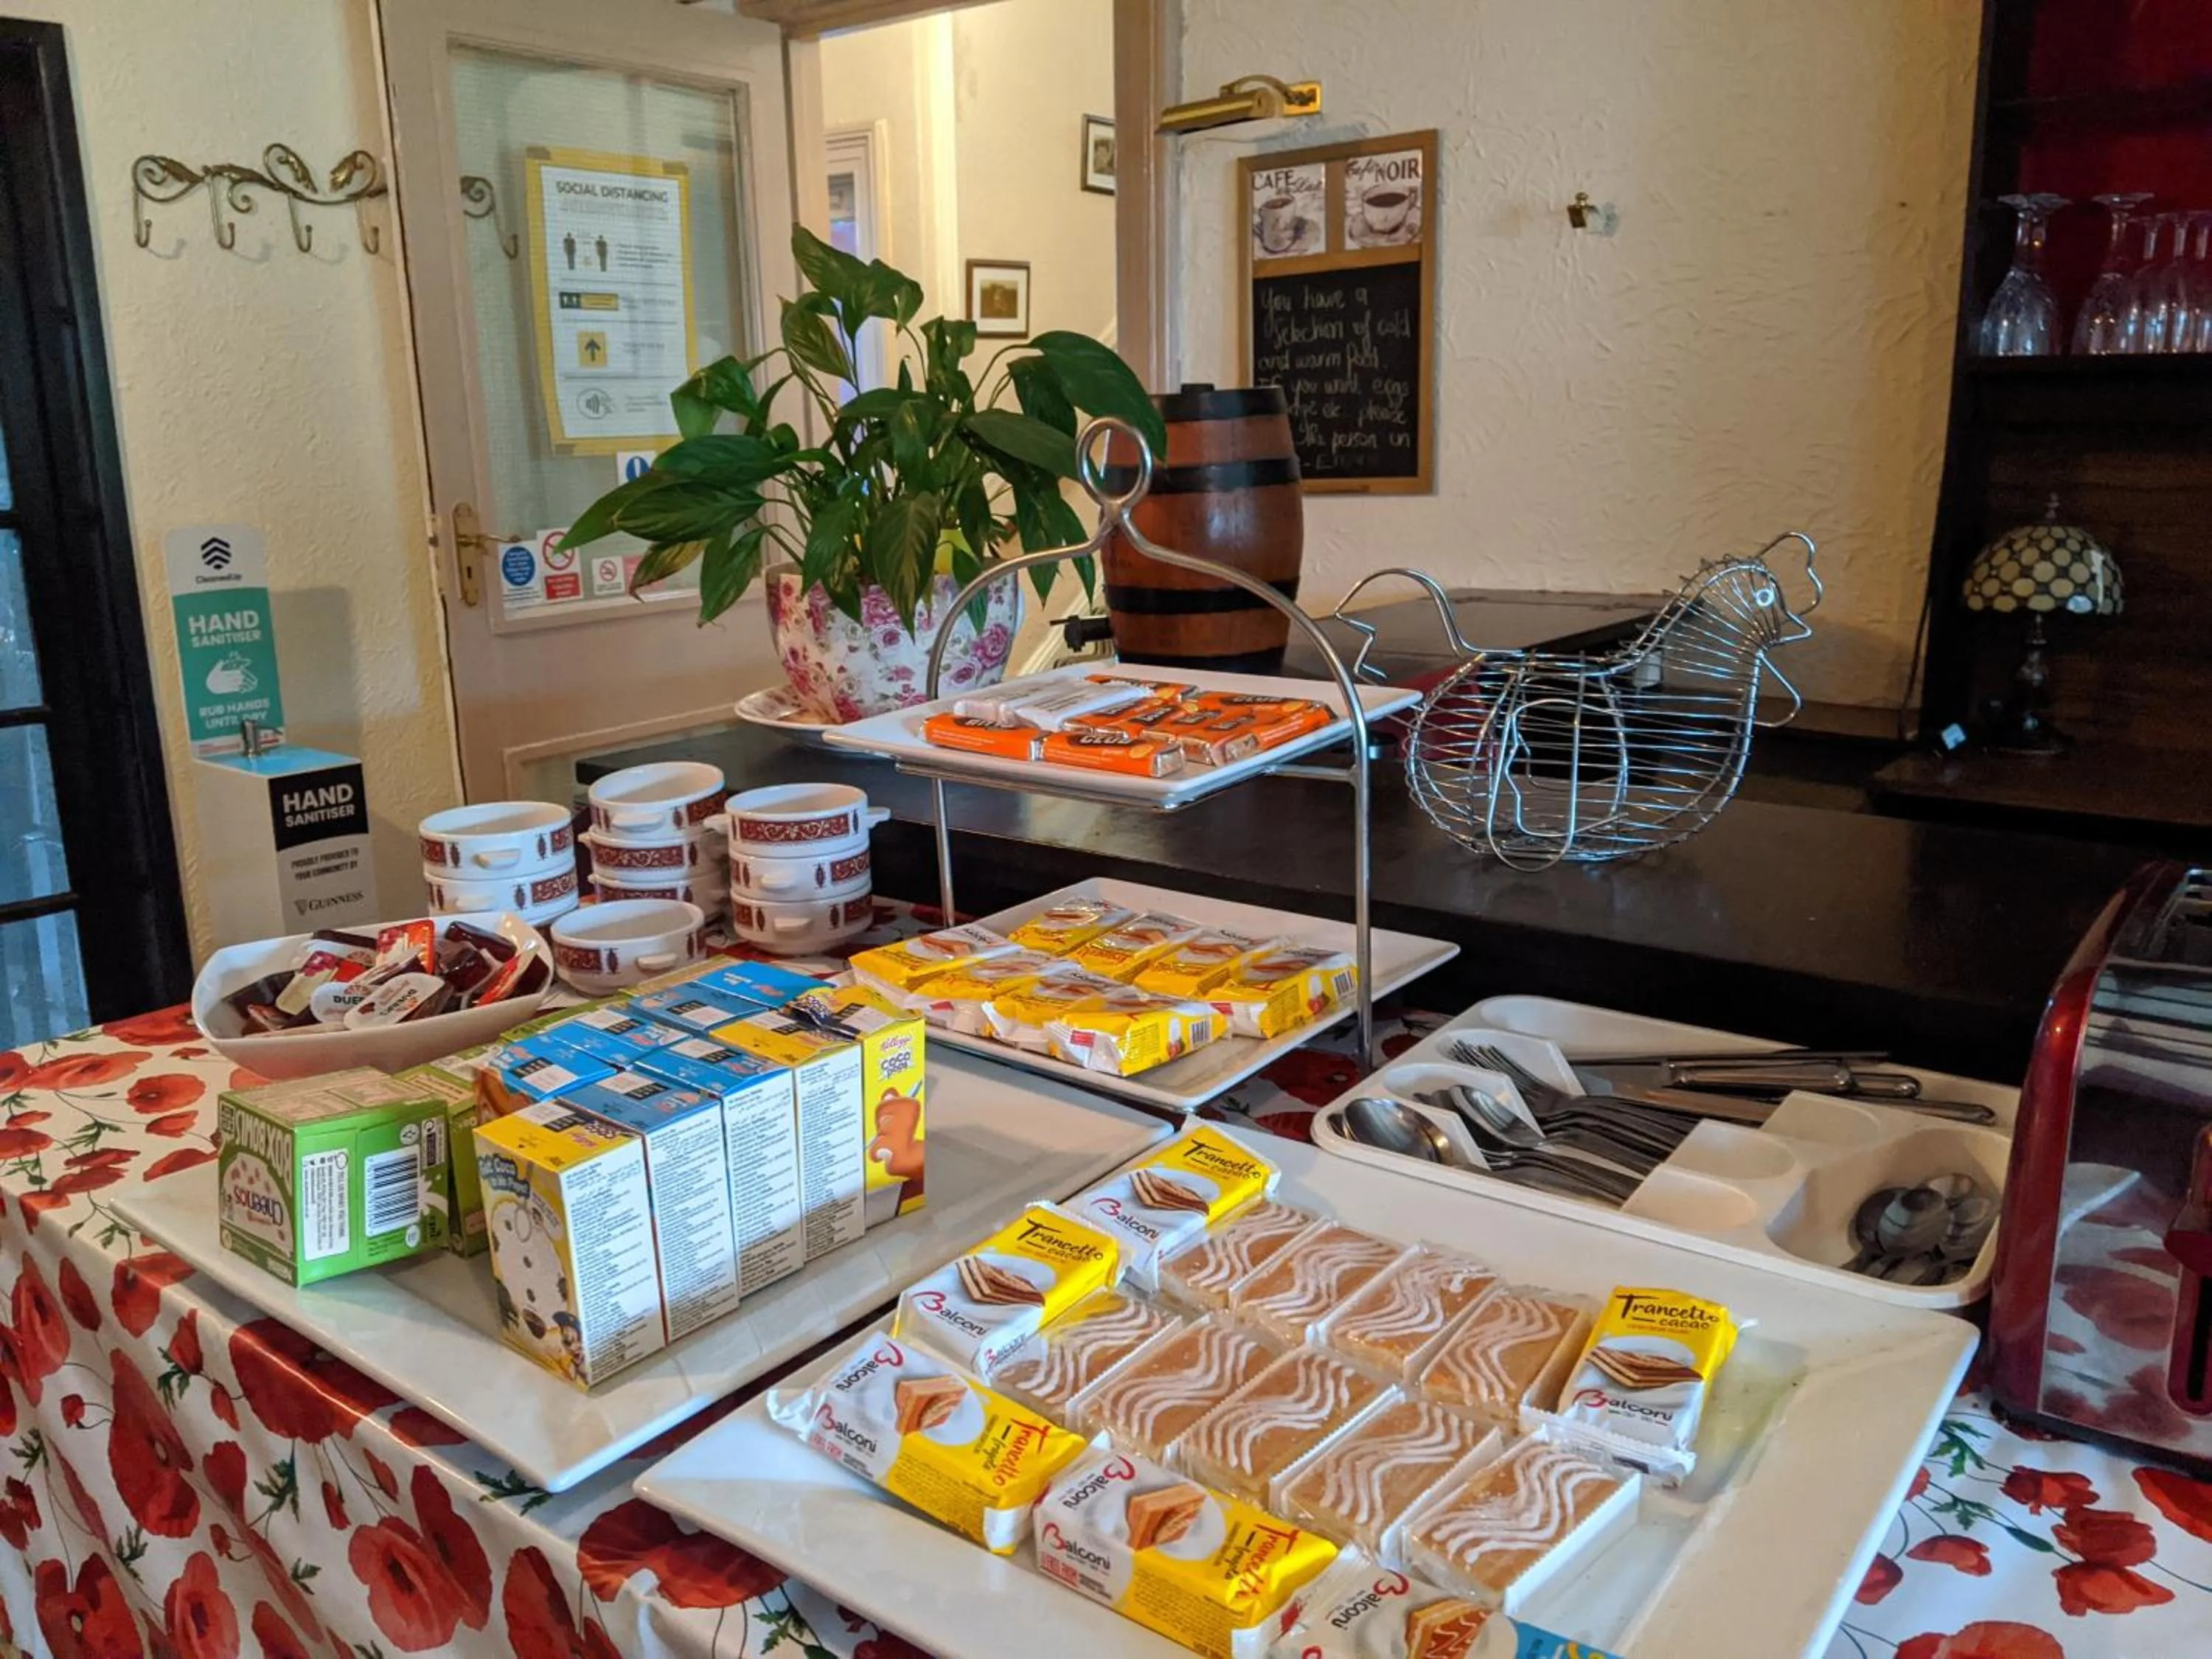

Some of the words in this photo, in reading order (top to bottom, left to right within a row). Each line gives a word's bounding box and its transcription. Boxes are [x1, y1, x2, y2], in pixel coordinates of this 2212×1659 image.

[1374, 158, 1420, 183] NOIR
[556, 180, 598, 198] SOCIAL
[600, 185, 669, 204] DISTANCING
[1304, 285, 1346, 310] have
[1377, 308, 1412, 338] cold
[1258, 349, 1290, 370] and
[1295, 352, 1342, 369] warm
[1371, 378, 1410, 408] eggs
[1331, 431, 1377, 455] person
[188, 610, 260, 636] HAND
[191, 630, 262, 648] SANITISER
[199, 705, 225, 717] RUB
[226, 698, 271, 714] HANDS
[206, 715, 238, 729] UNTIL
[282, 783, 354, 813] HAND
[285, 804, 356, 827] SANITISER
[308, 890, 365, 911] GUINNESS
[1180, 1138, 1262, 1180] Trancetto
[1090, 1197, 1160, 1242] Balconi
[1015, 1217, 1105, 1262] Trancetto
[910, 1290, 987, 1336] Balconi
[1615, 1294, 1720, 1324] Trancetto
[1658, 1317, 1711, 1330] cacao
[834, 1340, 905, 1393] Balconi
[1573, 1388, 1674, 1422] Balconi
[815, 1402, 877, 1454] Balconi
[992, 1417, 1052, 1487] Trancetto
[1062, 1454, 1136, 1511] Balconi
[1040, 1521, 1112, 1571] Balconi
[1330, 1569, 1411, 1631] Balconi
